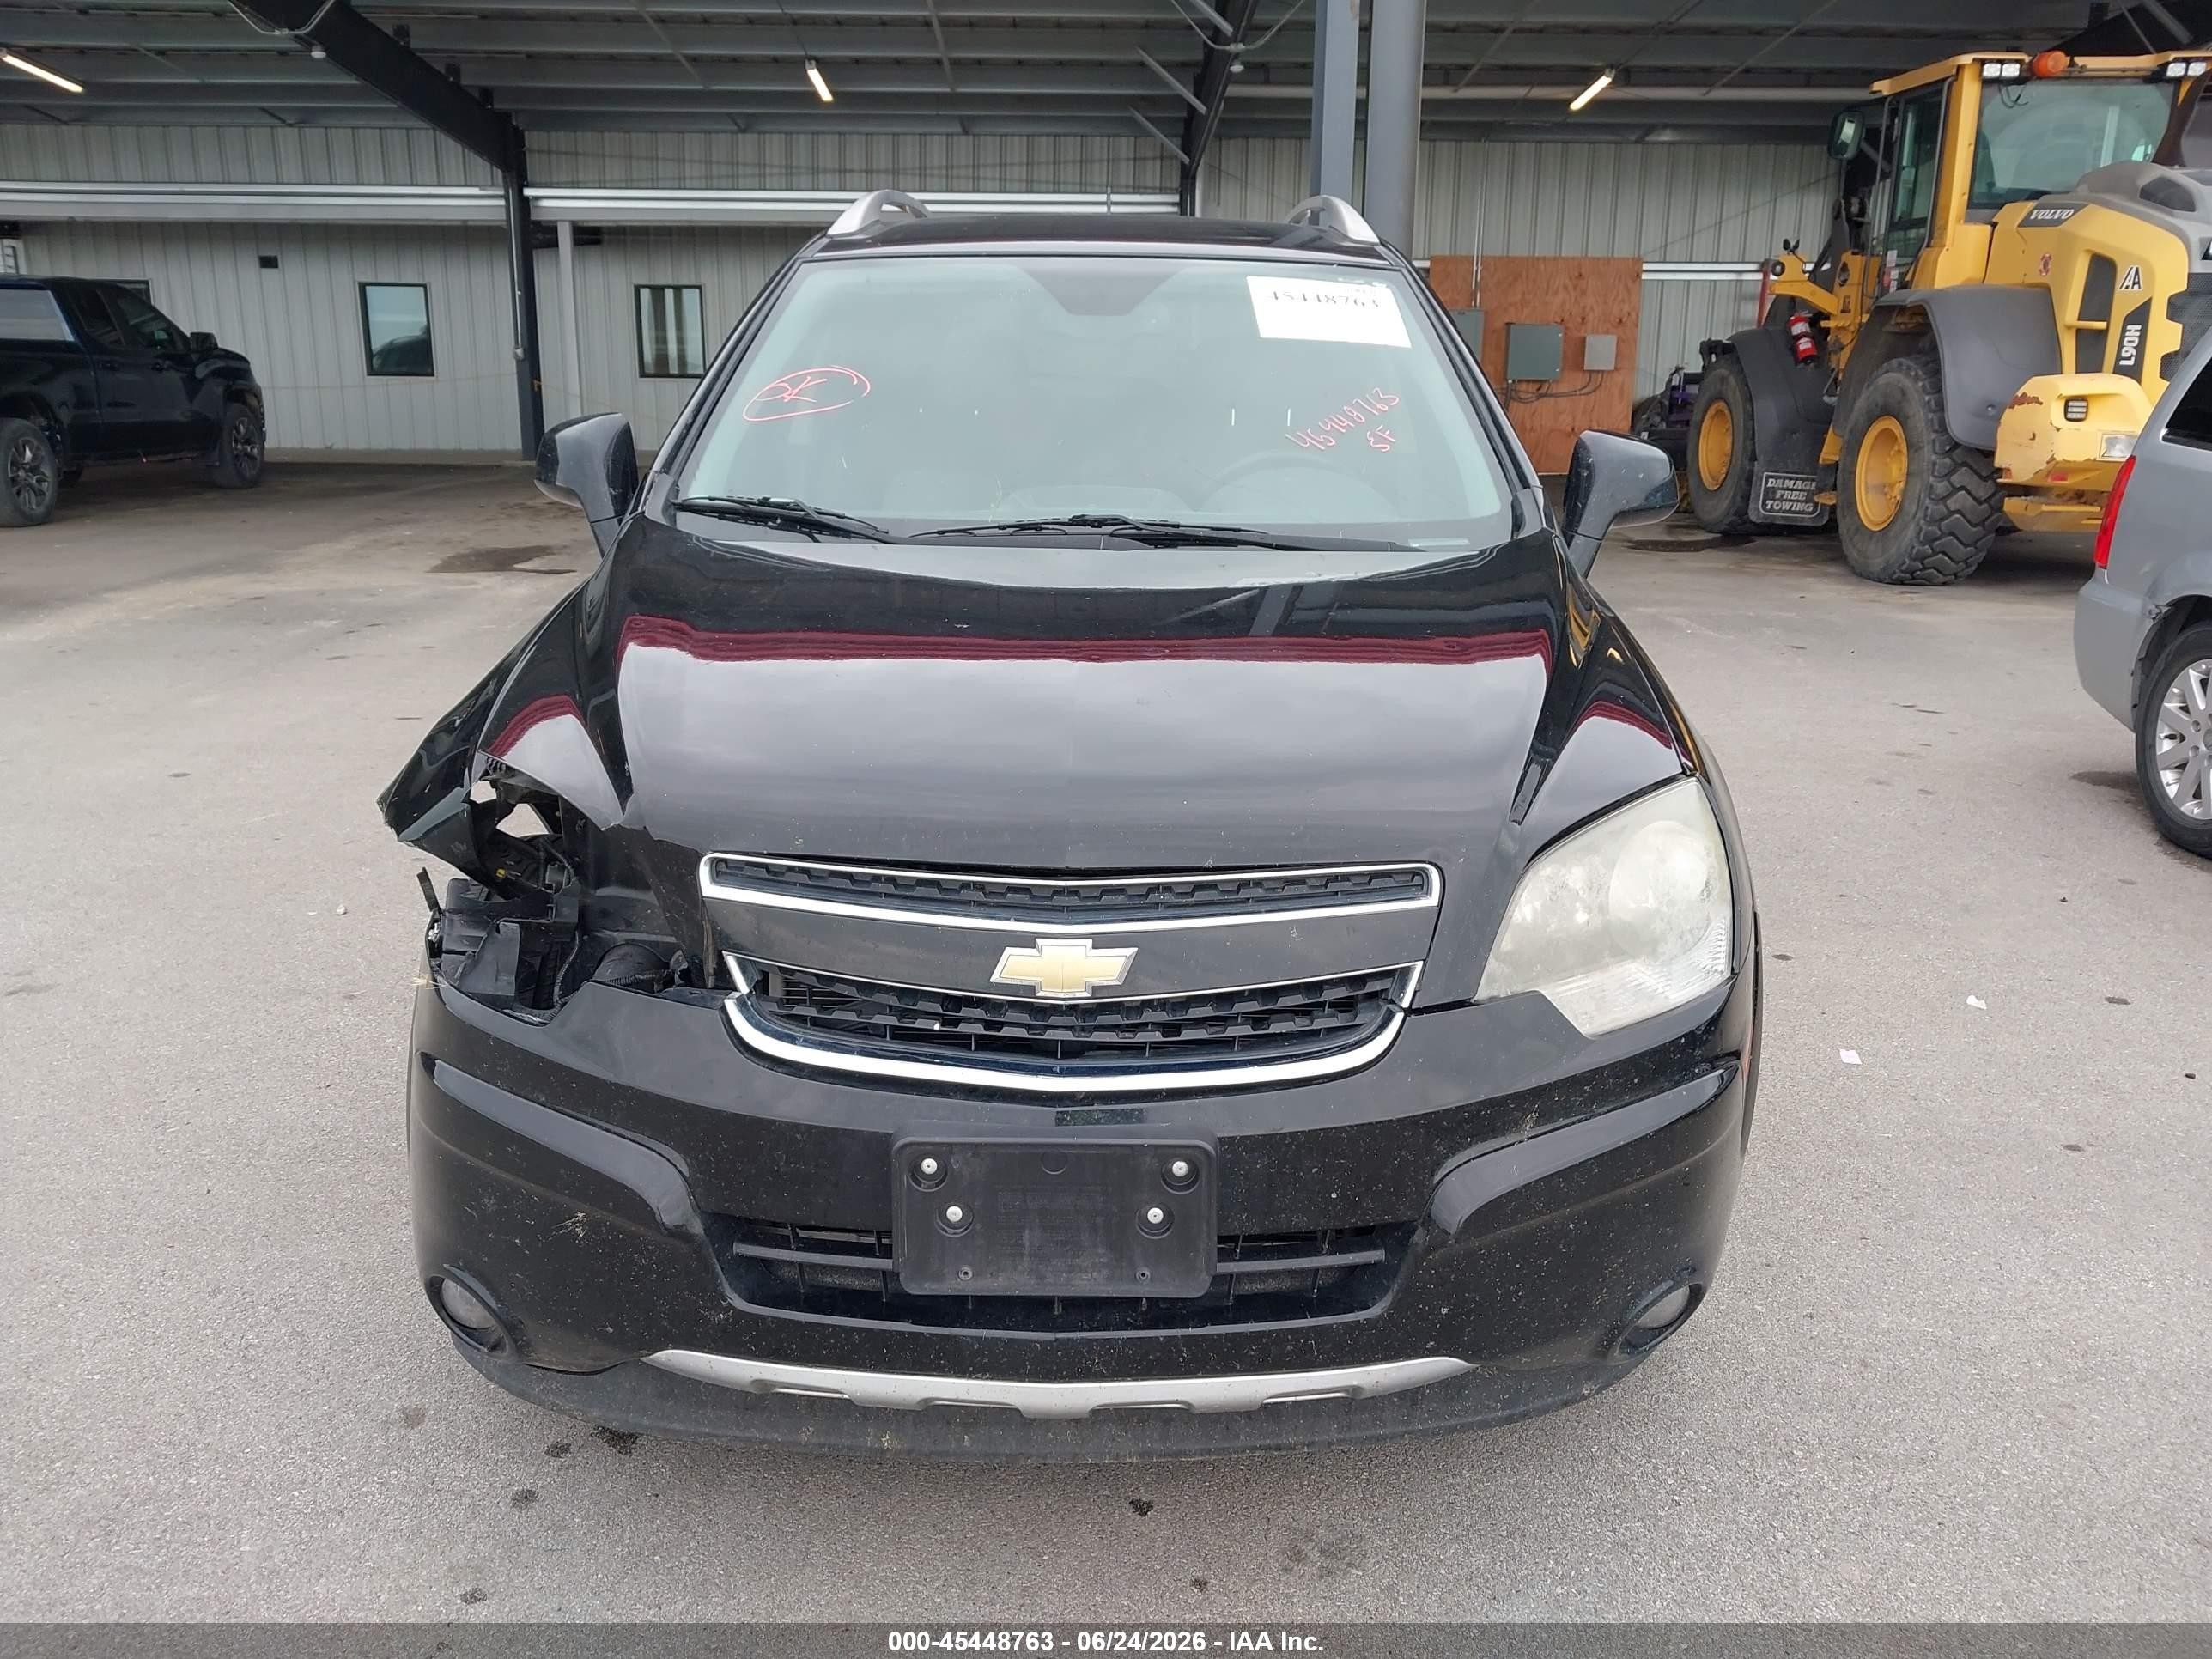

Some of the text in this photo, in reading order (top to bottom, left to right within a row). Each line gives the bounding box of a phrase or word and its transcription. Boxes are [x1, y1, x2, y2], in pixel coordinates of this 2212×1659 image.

[2029, 209, 2075, 220] VOLVO
[2119, 325, 2142, 366] L90H
[1285, 387, 1400, 450] 45448763
[1775, 490, 1808, 501] FREE
[1765, 501, 1814, 512] TOWING
